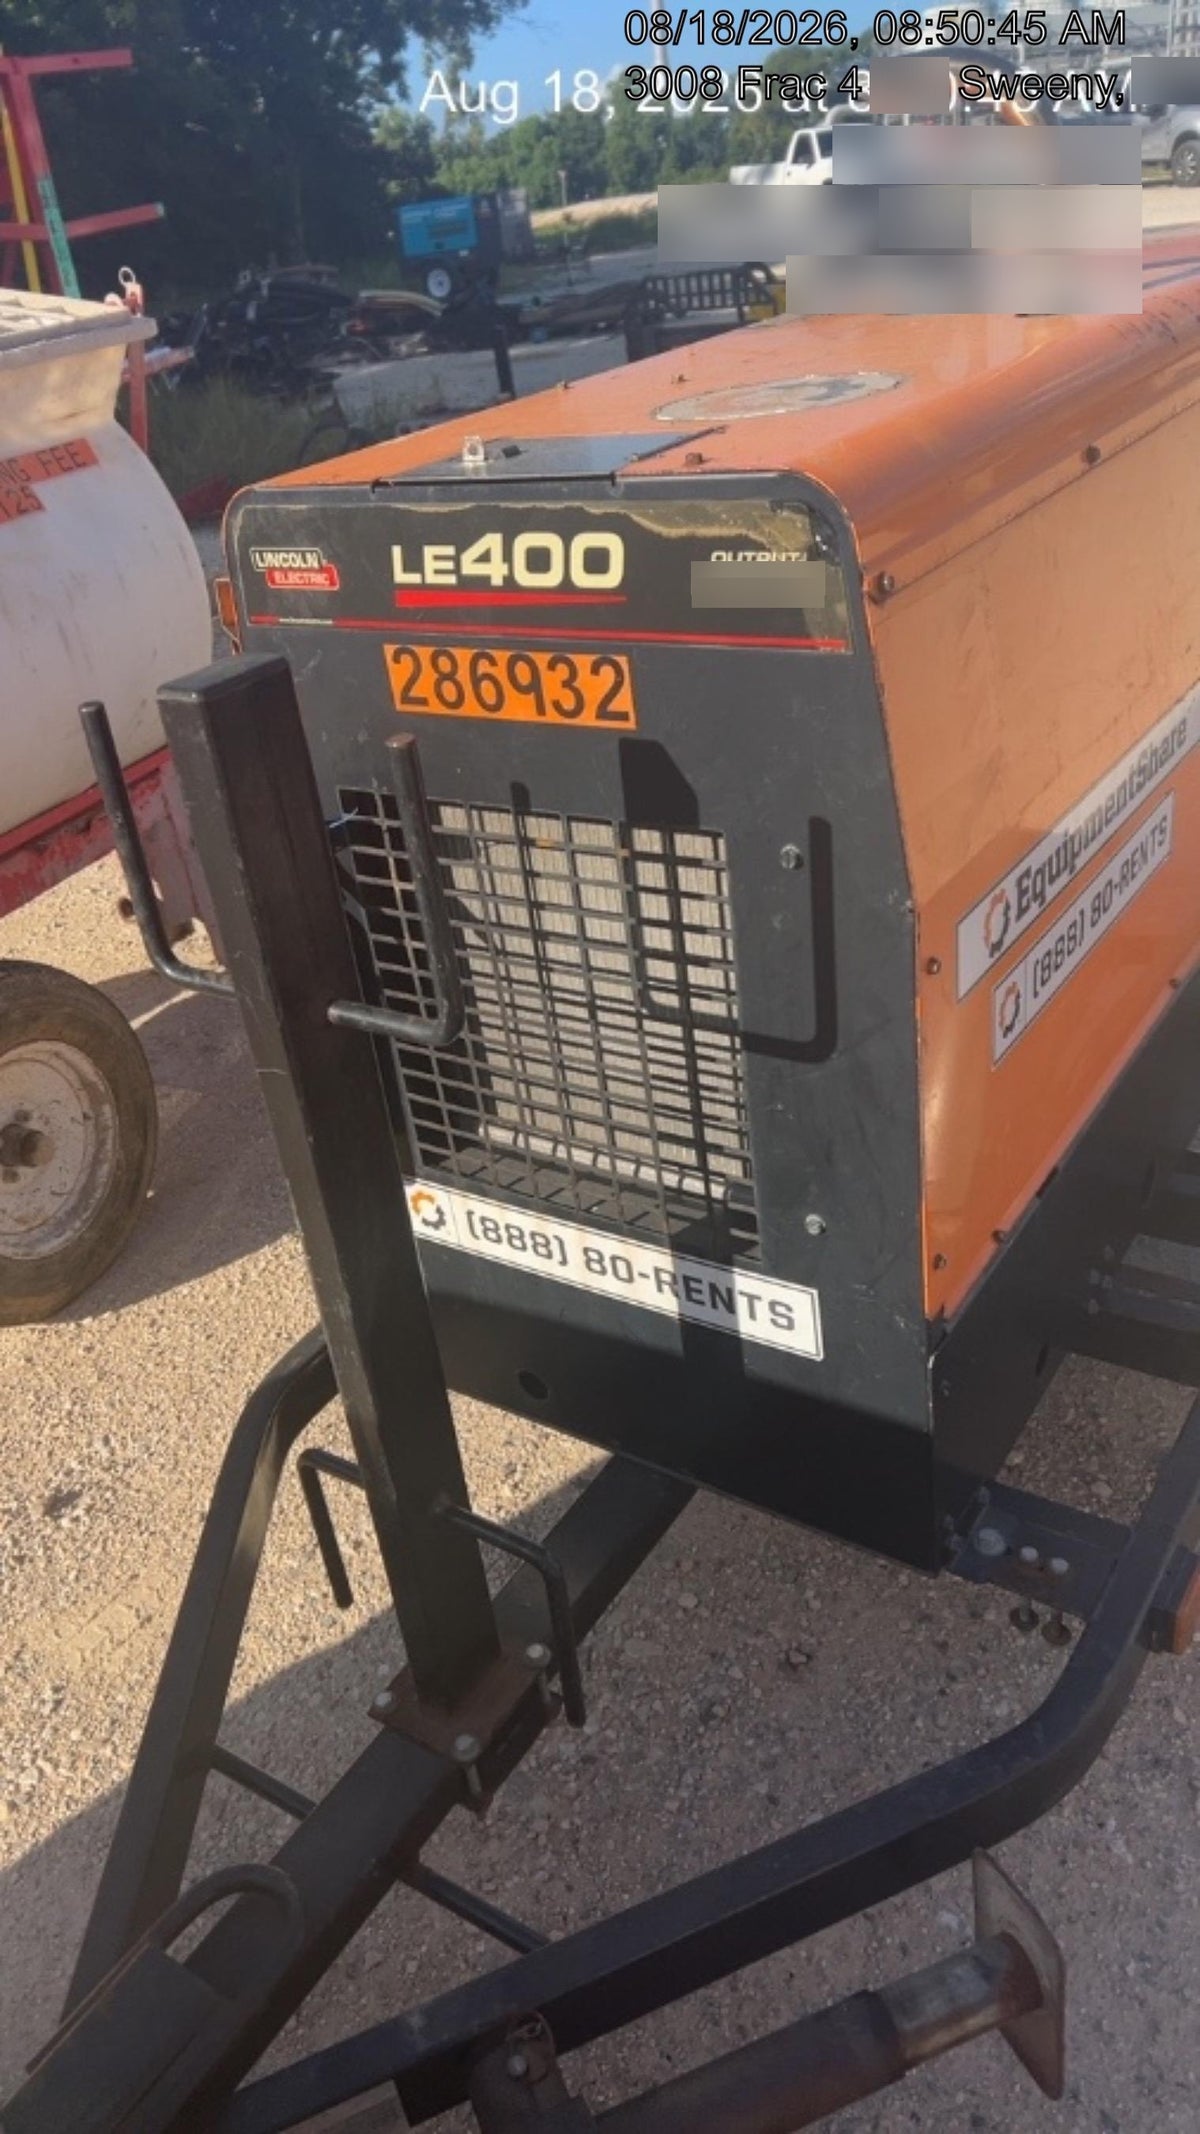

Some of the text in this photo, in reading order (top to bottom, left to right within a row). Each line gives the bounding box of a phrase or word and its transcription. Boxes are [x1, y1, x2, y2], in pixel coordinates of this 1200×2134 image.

[36, 442, 87, 476] FEE
[255, 551, 320, 569] LINCOLN
[274, 571, 330, 585] ELECTRIC
[391, 532, 624, 589] LE400
[391, 646, 630, 721] 286932
[1014, 717, 1188, 926] EquipmentShare
[1032, 814, 1168, 999] (888) 80-RENTS
[466, 1209, 797, 1332] (888) 80-RENTS
